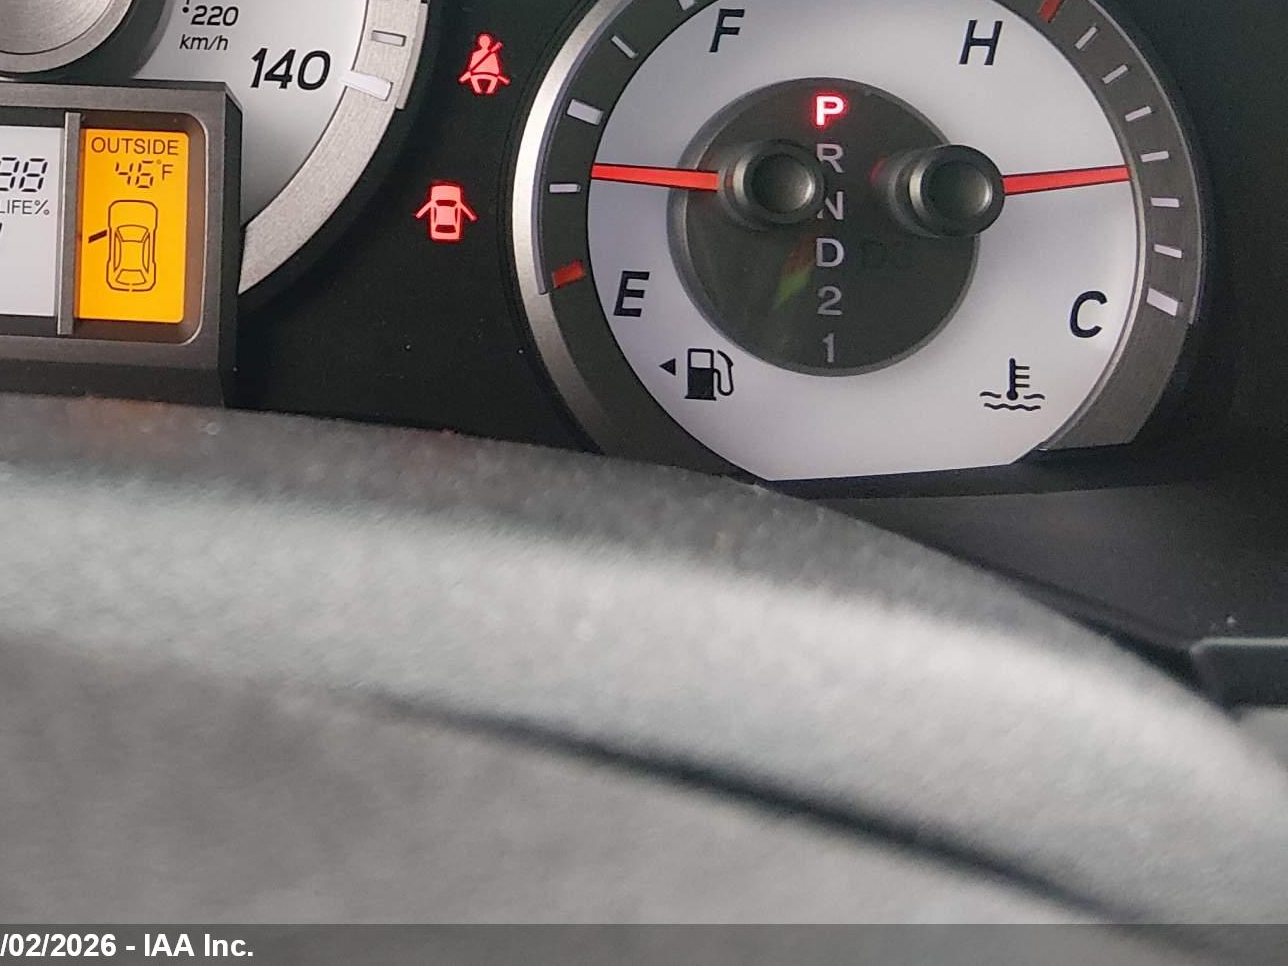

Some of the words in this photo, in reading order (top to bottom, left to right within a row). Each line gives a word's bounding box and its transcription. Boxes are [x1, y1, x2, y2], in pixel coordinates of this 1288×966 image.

[192, 5, 239, 27] 220
[710, 8, 744, 52] F
[178, 33, 230, 53] km/h
[959, 19, 1002, 65] H
[249, 49, 330, 90] 140
[816, 96, 845, 125] P
[91, 137, 179, 156] OUTSIDE
[817, 145, 843, 174] R
[816, 239, 844, 268] D
[614, 271, 649, 317] E
[817, 287, 843, 315] 2
[1069, 291, 1107, 338] C
[823, 334, 836, 362] 1
